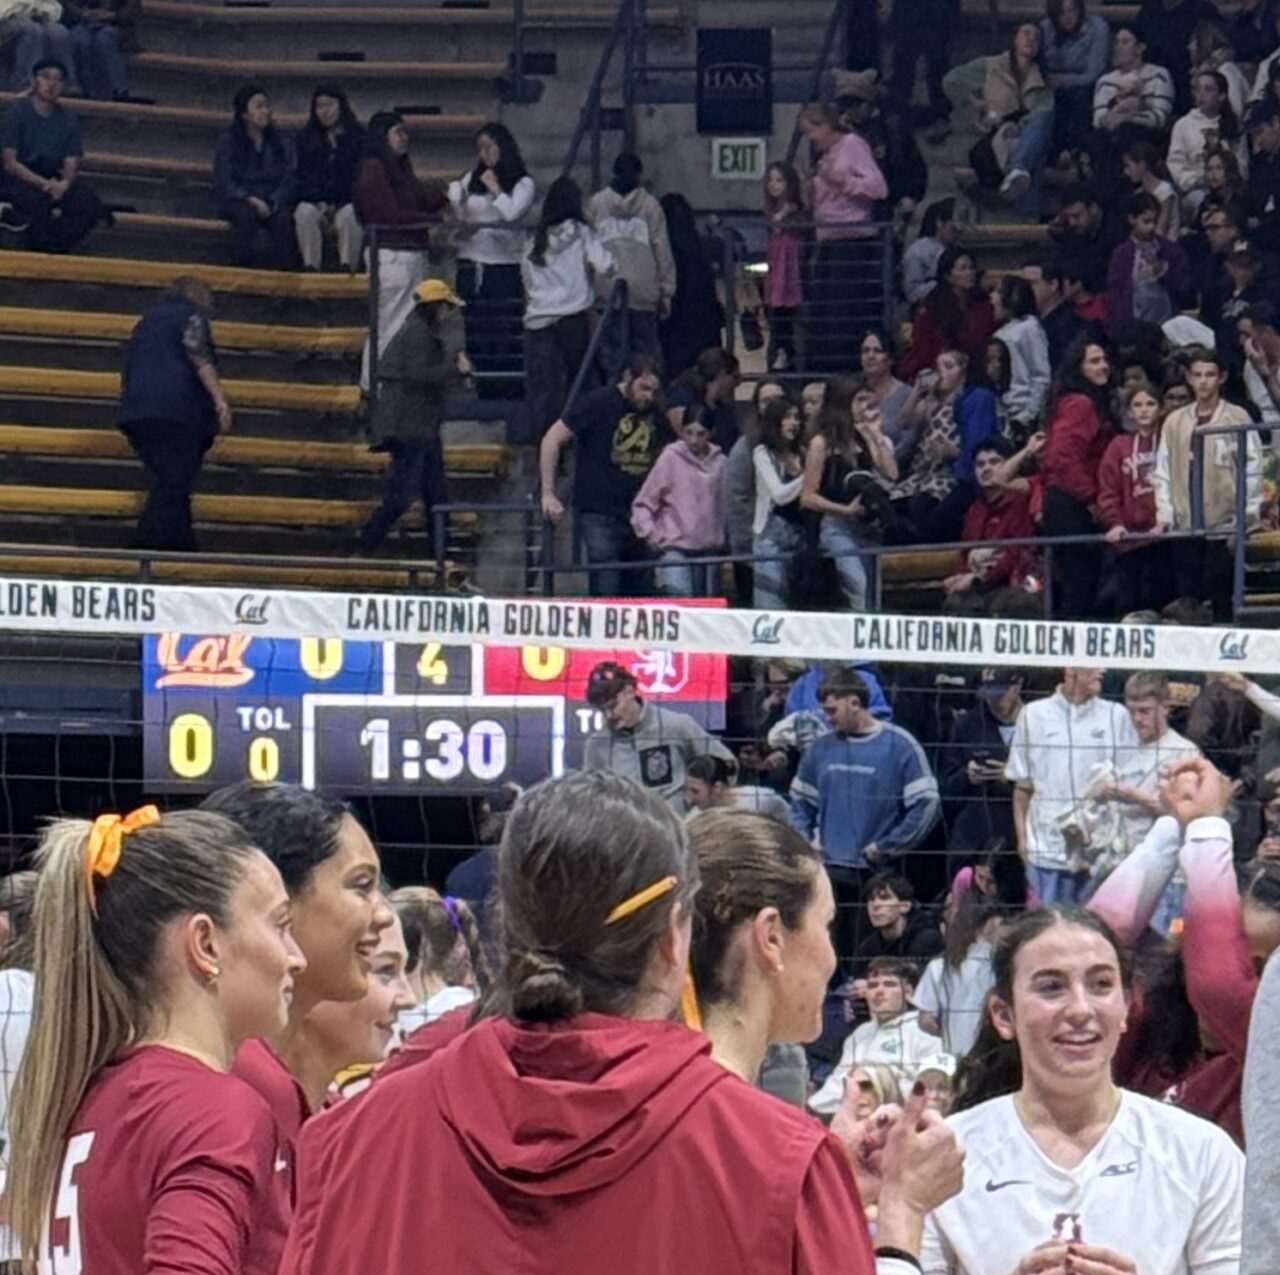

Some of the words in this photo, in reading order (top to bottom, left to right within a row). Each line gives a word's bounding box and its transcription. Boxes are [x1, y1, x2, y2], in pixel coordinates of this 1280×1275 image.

[720, 145, 758, 172] EXIT
[72, 585, 156, 621] BEARS
[235, 594, 270, 625] Cal
[347, 598, 491, 635] CALIFORNIA
[503, 603, 592, 639] GOLDEN
[605, 607, 681, 642] BEARS
[750, 614, 785, 644] Cal
[852, 617, 983, 653] CALIFORNIA
[994, 622, 1075, 657] GOLDEN
[1086, 626, 1156, 659] BEARS
[1218, 631, 1248, 661] Cal
[155, 632, 255, 690] Cal
[237, 706, 291, 732] TOL
[169, 712, 213, 779] 0
[249, 737, 279, 783] 0
[360, 718, 508, 782] 1:30
